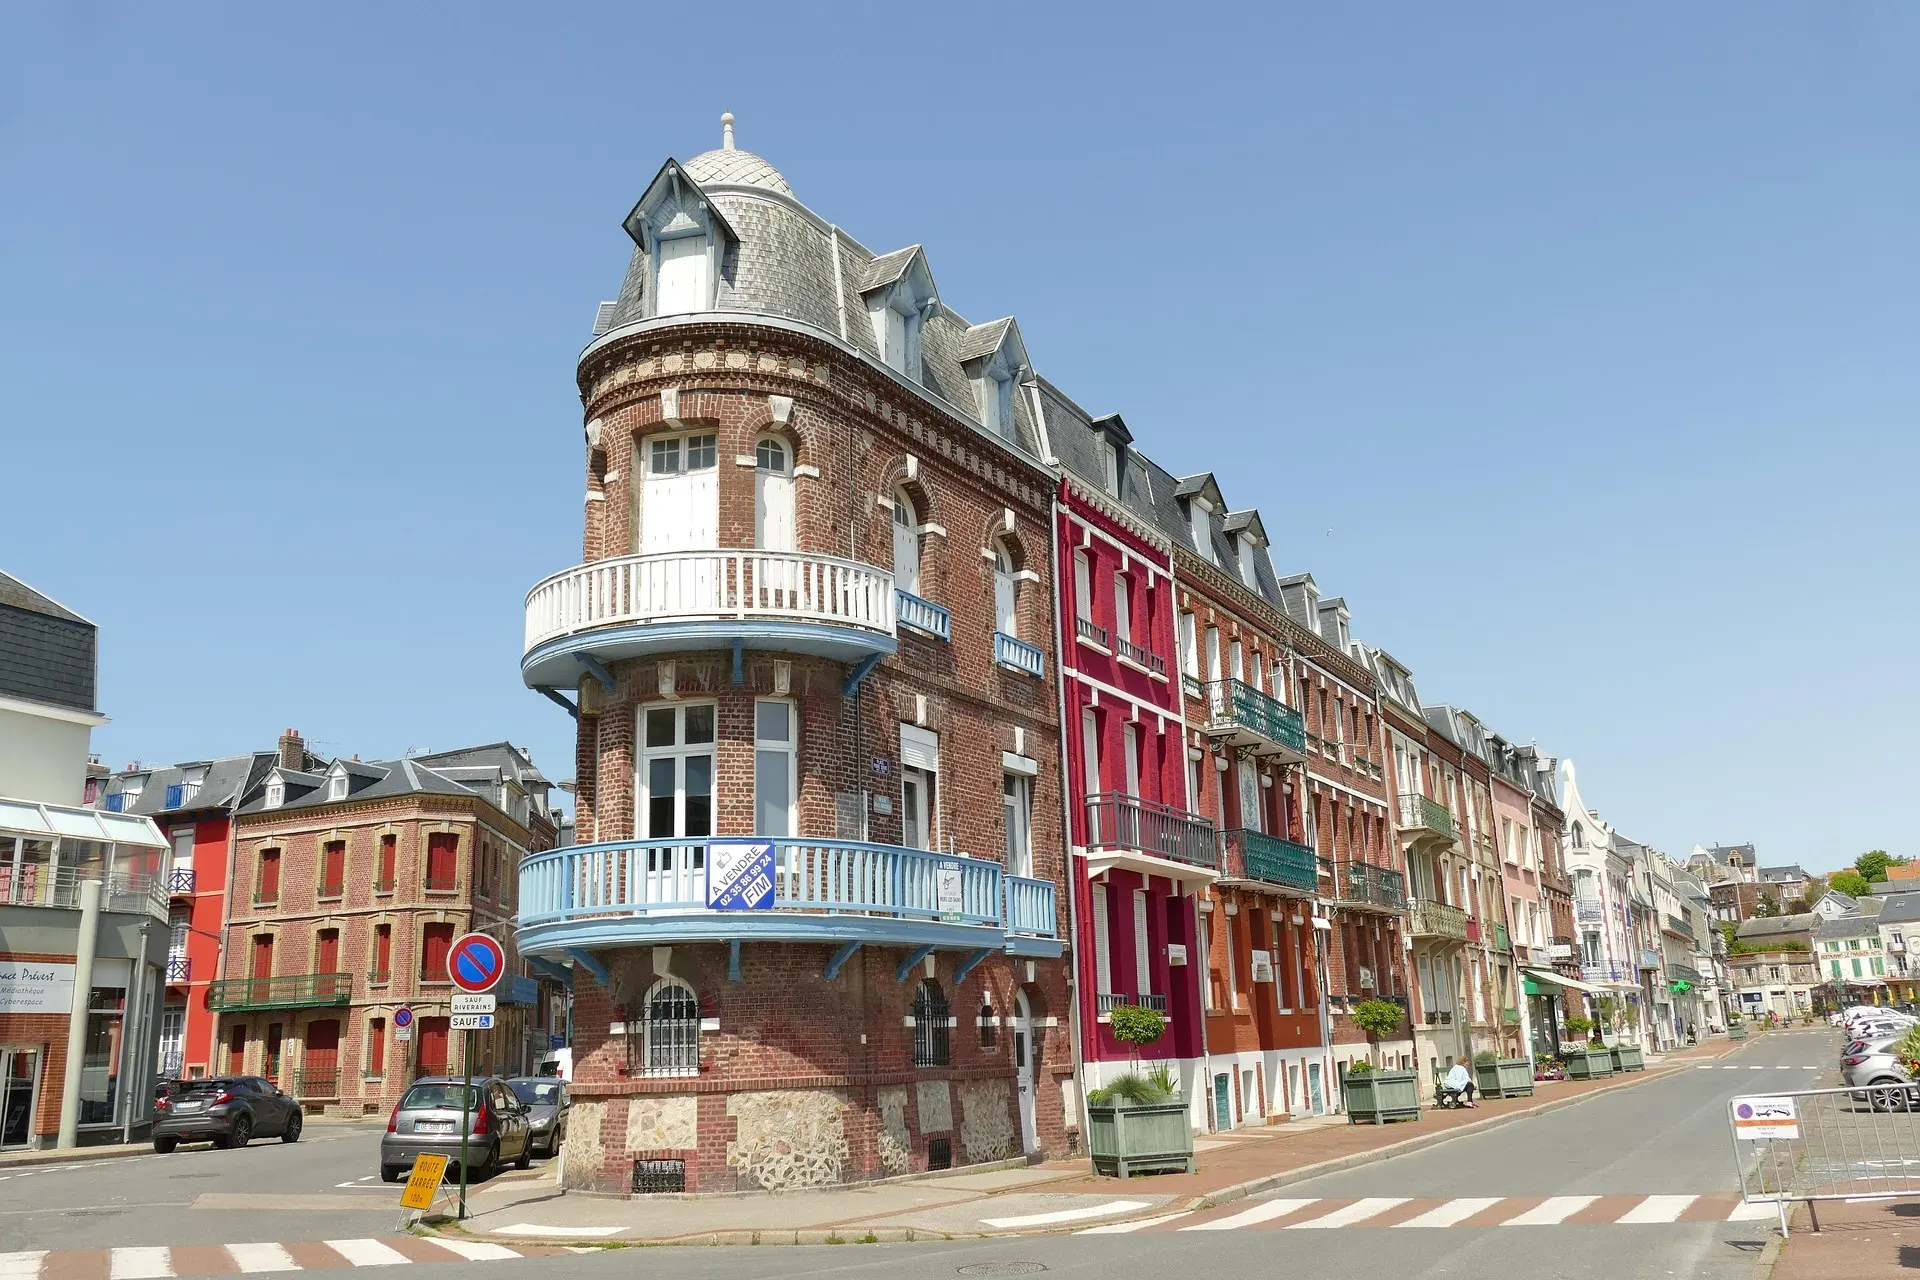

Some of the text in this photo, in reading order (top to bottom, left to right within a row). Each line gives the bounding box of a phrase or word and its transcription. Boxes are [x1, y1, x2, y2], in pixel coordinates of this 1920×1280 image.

[712, 846, 761, 896] A VENDRE
[943, 862, 959, 871] VENDRE
[720, 854, 772, 906] 02 35 86 99 24
[745, 876, 770, 904] FIM
[22, 968, 55, 981] Prévert
[0, 998, 44, 1006] Cyberespace
[452, 1017, 478, 1026] SAUF
[419, 1161, 440, 1173] ROUTE
